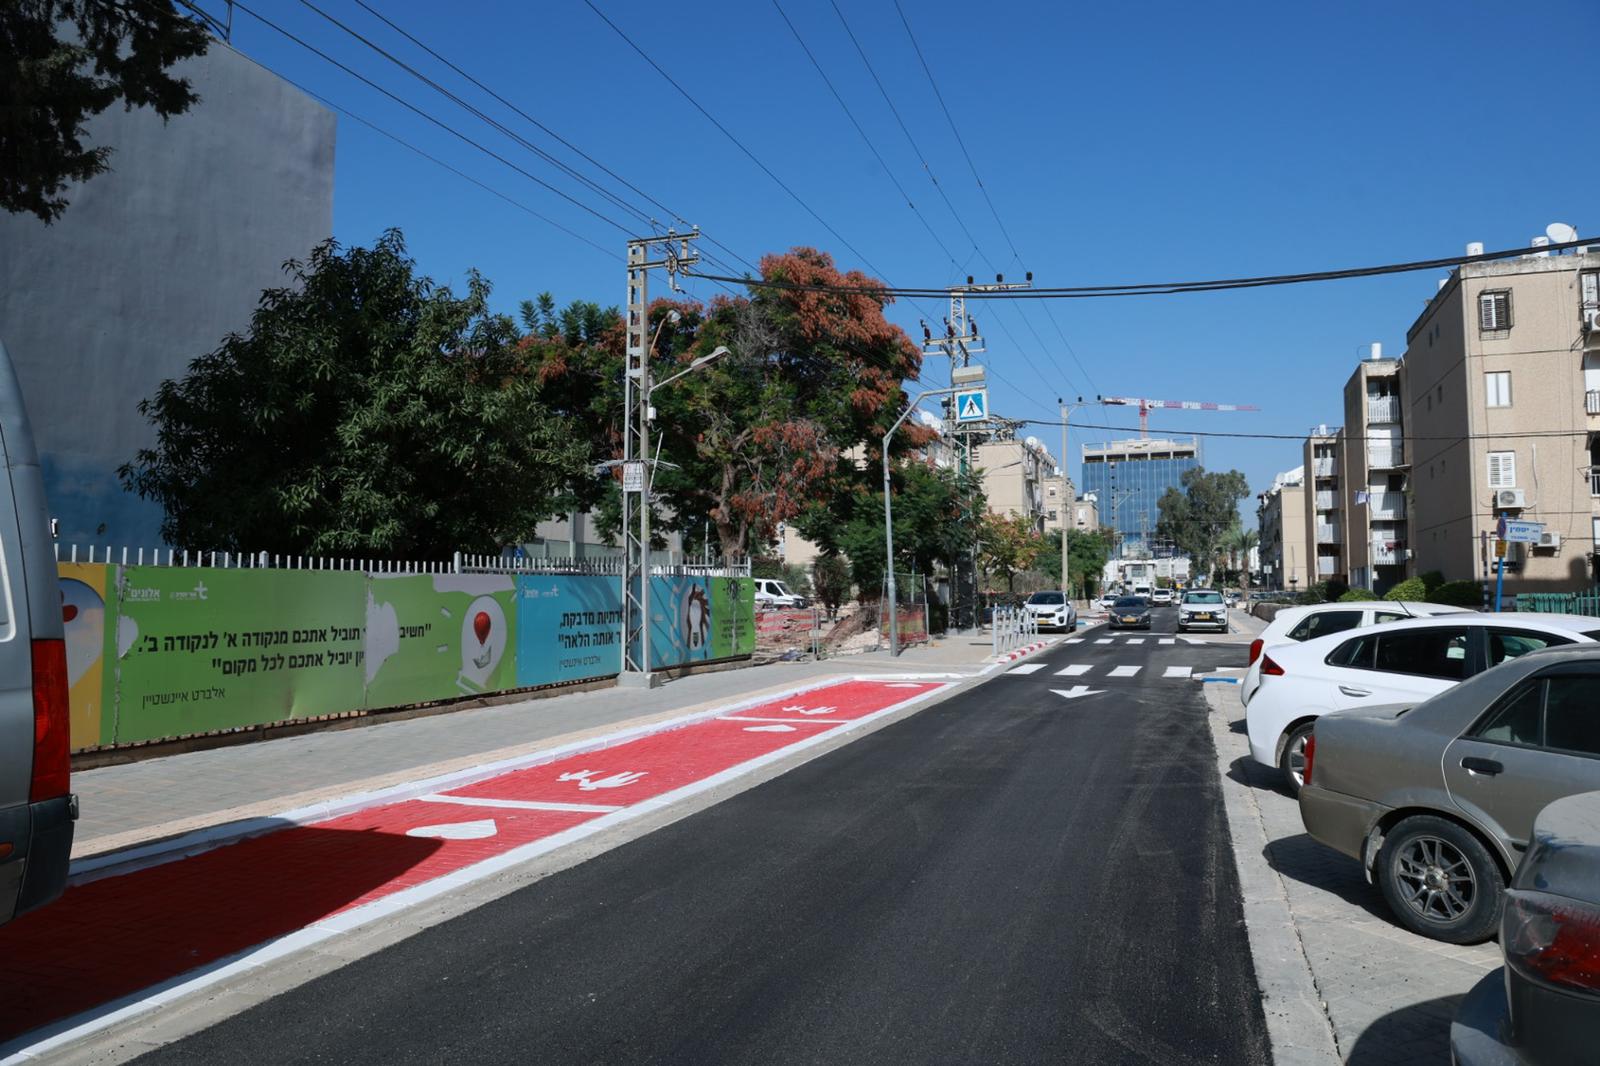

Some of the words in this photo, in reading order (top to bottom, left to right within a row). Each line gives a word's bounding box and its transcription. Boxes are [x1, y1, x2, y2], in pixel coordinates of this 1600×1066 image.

[293, 629, 327, 644] אתכם
[331, 626, 360, 642] תוביל
[400, 624, 432, 638] "חשיב
[593, 631, 614, 646] אותה
[164, 631, 218, 653] לנקודה
[224, 632, 238, 648] א'
[242, 631, 288, 648] מנקודה
[558, 631, 590, 648] הלאה"
[261, 653, 284, 672] לכל
[289, 653, 324, 669] אתכם
[328, 650, 353, 665] יוביל
[212, 657, 256, 676] מקום"
[142, 691, 188, 710] איינשטיין
[192, 685, 225, 701] אלברט
